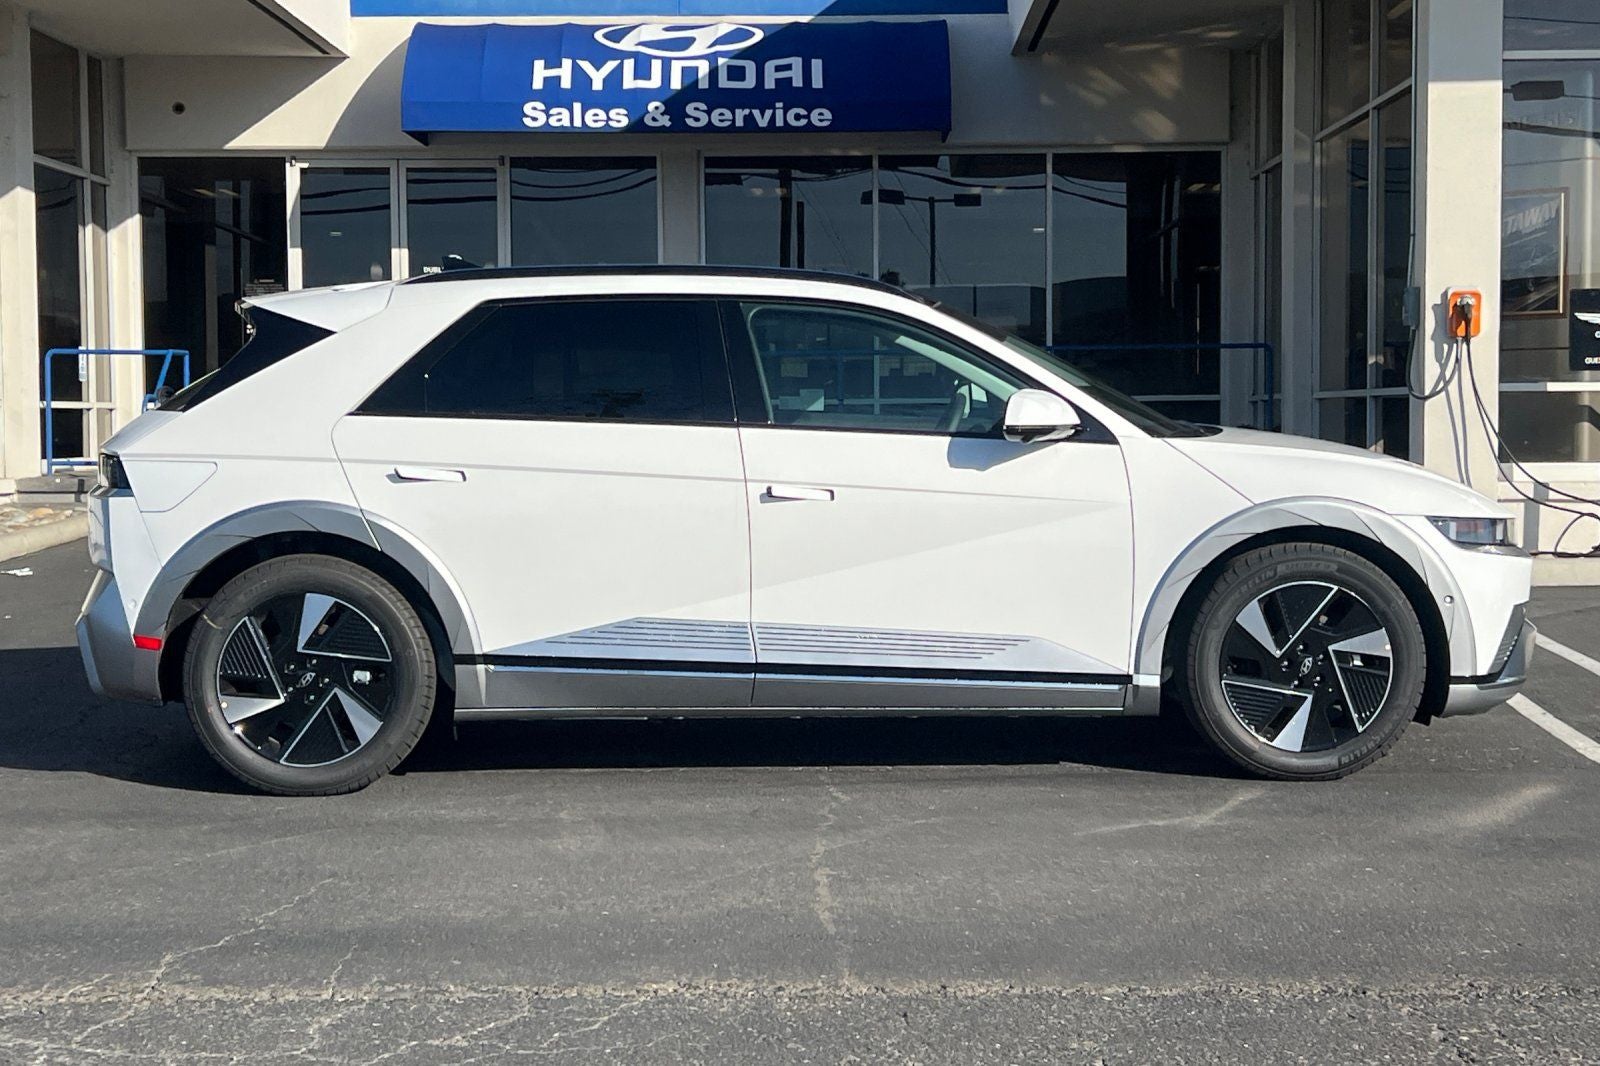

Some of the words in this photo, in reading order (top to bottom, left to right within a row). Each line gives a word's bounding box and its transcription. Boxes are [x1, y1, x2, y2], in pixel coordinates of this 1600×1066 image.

[532, 57, 823, 90] HYUNDAI
[522, 102, 629, 128] Sales
[643, 101, 672, 127] &
[684, 102, 833, 127] Service
